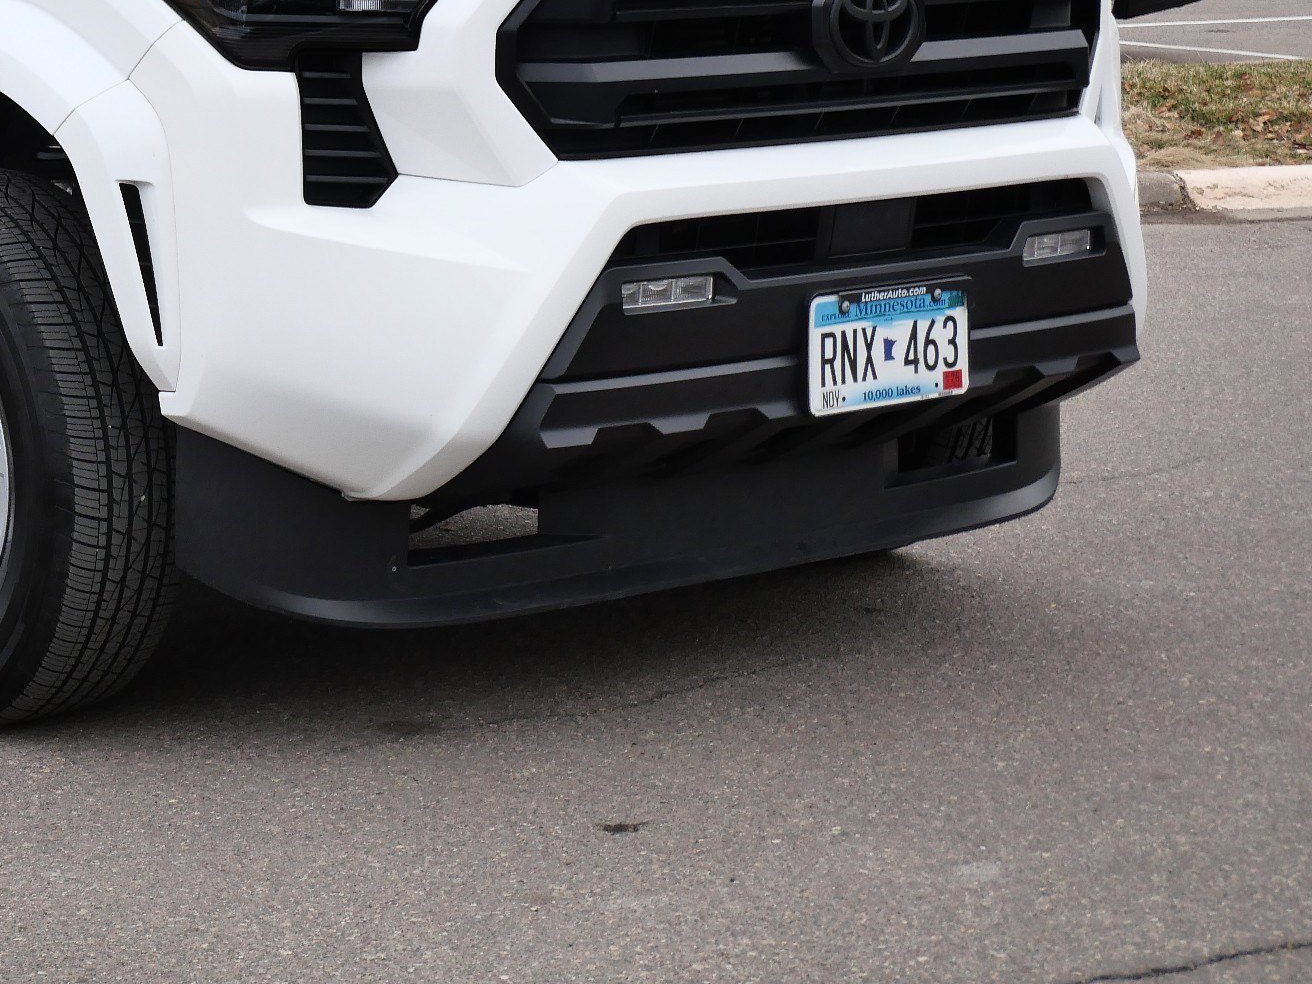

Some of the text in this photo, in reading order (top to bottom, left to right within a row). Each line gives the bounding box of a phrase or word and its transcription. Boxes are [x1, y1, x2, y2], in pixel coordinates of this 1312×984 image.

[861, 286, 927, 303] LutherAuto.com
[820, 315, 959, 388] RNX 463
[822, 389, 840, 409] NOV
[862, 383, 921, 402] 10,000 lakes
